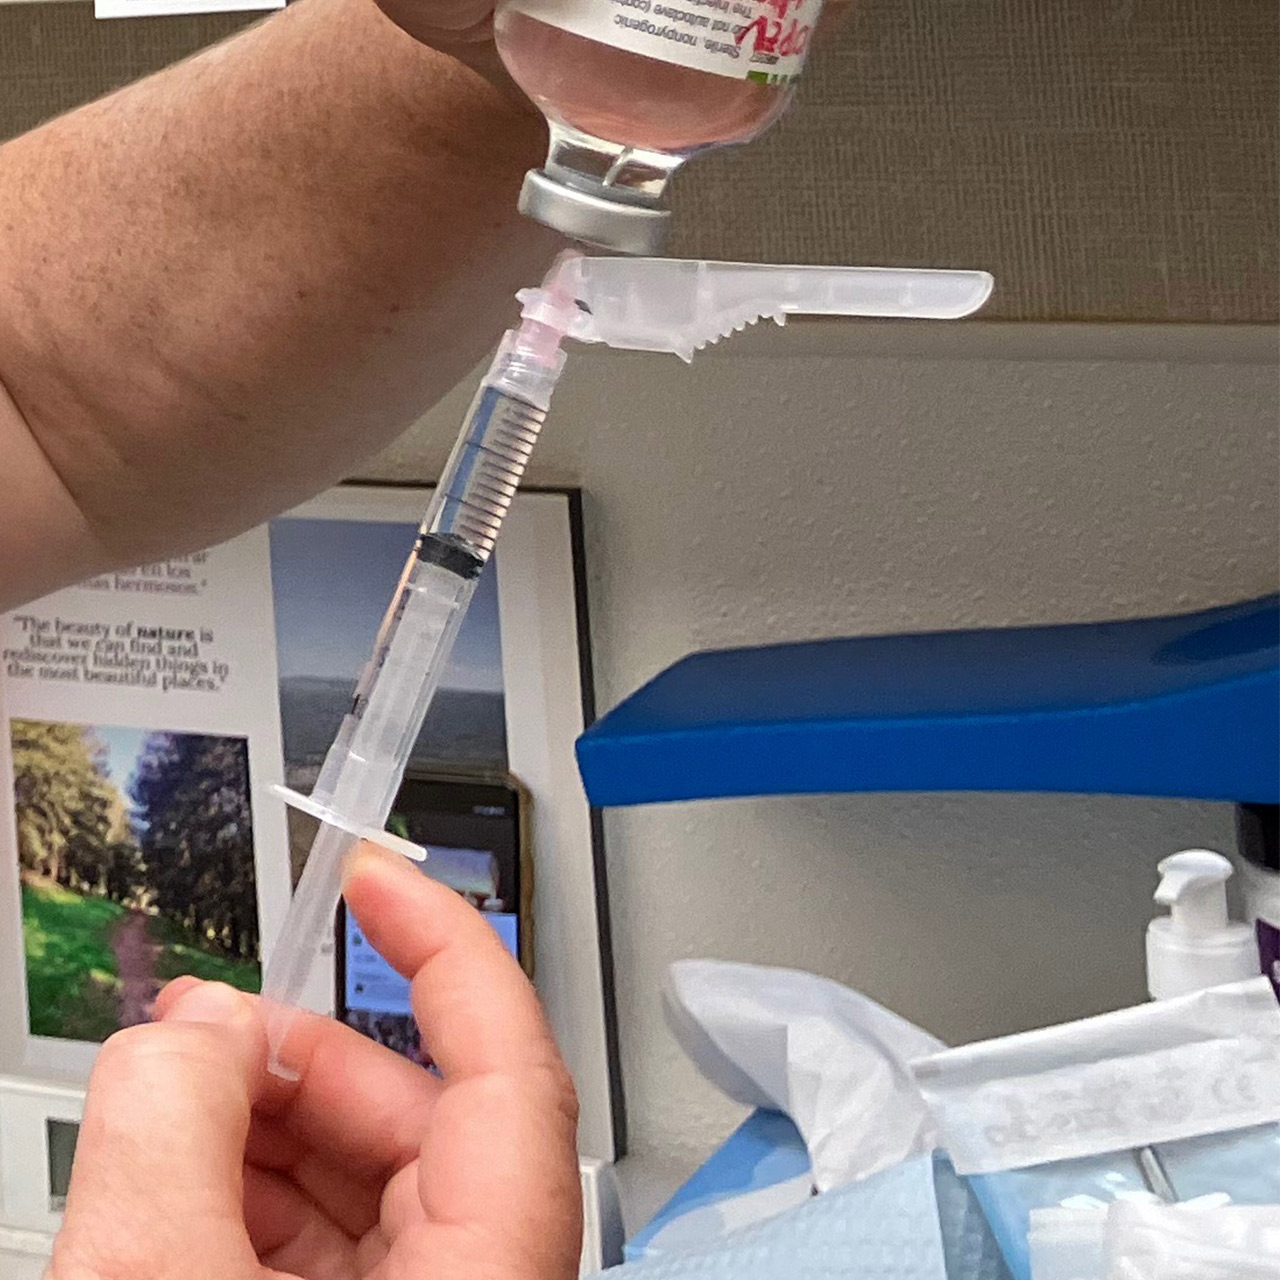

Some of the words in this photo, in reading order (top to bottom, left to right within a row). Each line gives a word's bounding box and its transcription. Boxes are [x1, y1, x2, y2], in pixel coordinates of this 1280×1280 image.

[653, 4, 710, 28] autoclave
[732, 2, 752, 19] The
[614, 14, 698, 46] nonpyrogenic
[711, 19, 730, 32] not
[54, 616, 110, 639] beauty
[114, 620, 134, 637] of
[136, 625, 195, 641] nature
[199, 625, 214, 642] is
[129, 636, 163, 655] find
[166, 640, 199, 658] and
[6, 661, 34, 679] the
[82, 669, 159, 688] beautiful
[92, 651, 152, 669] hidden
[155, 655, 209, 676] things
